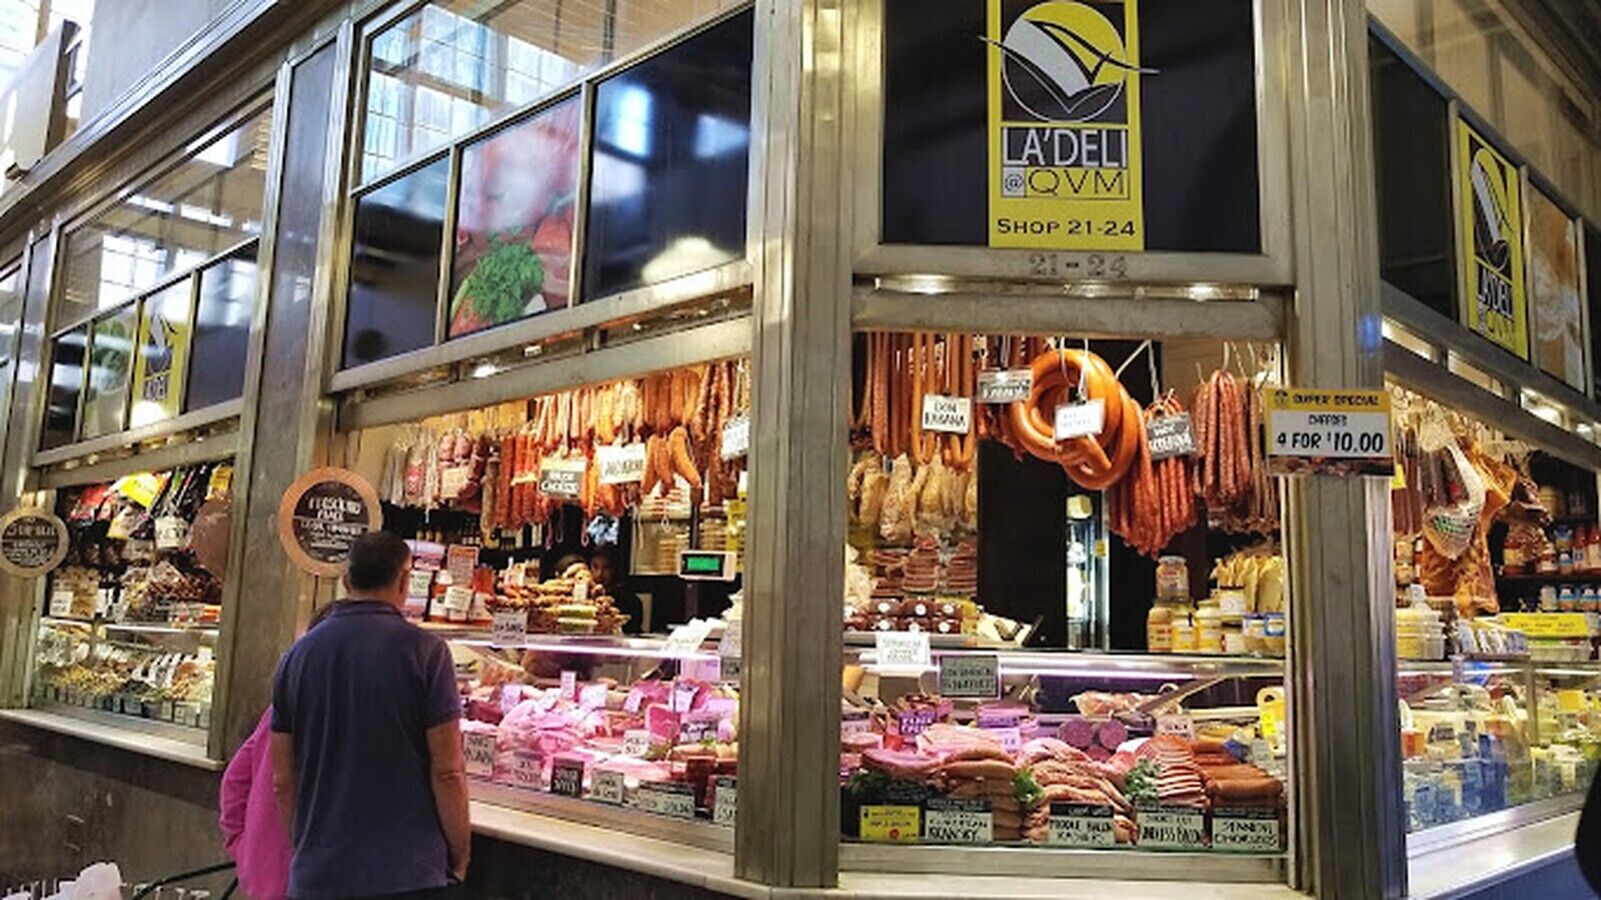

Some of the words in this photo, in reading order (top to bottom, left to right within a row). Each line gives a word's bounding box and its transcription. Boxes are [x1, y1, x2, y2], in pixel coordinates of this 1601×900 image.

[1003, 128, 1127, 168] LA'DELI
[997, 218, 1060, 235] SHOP
[1067, 219, 1136, 236] 21-24
[1334, 394, 1379, 406] SPECIAL
[1292, 432, 1322, 449] FOR
